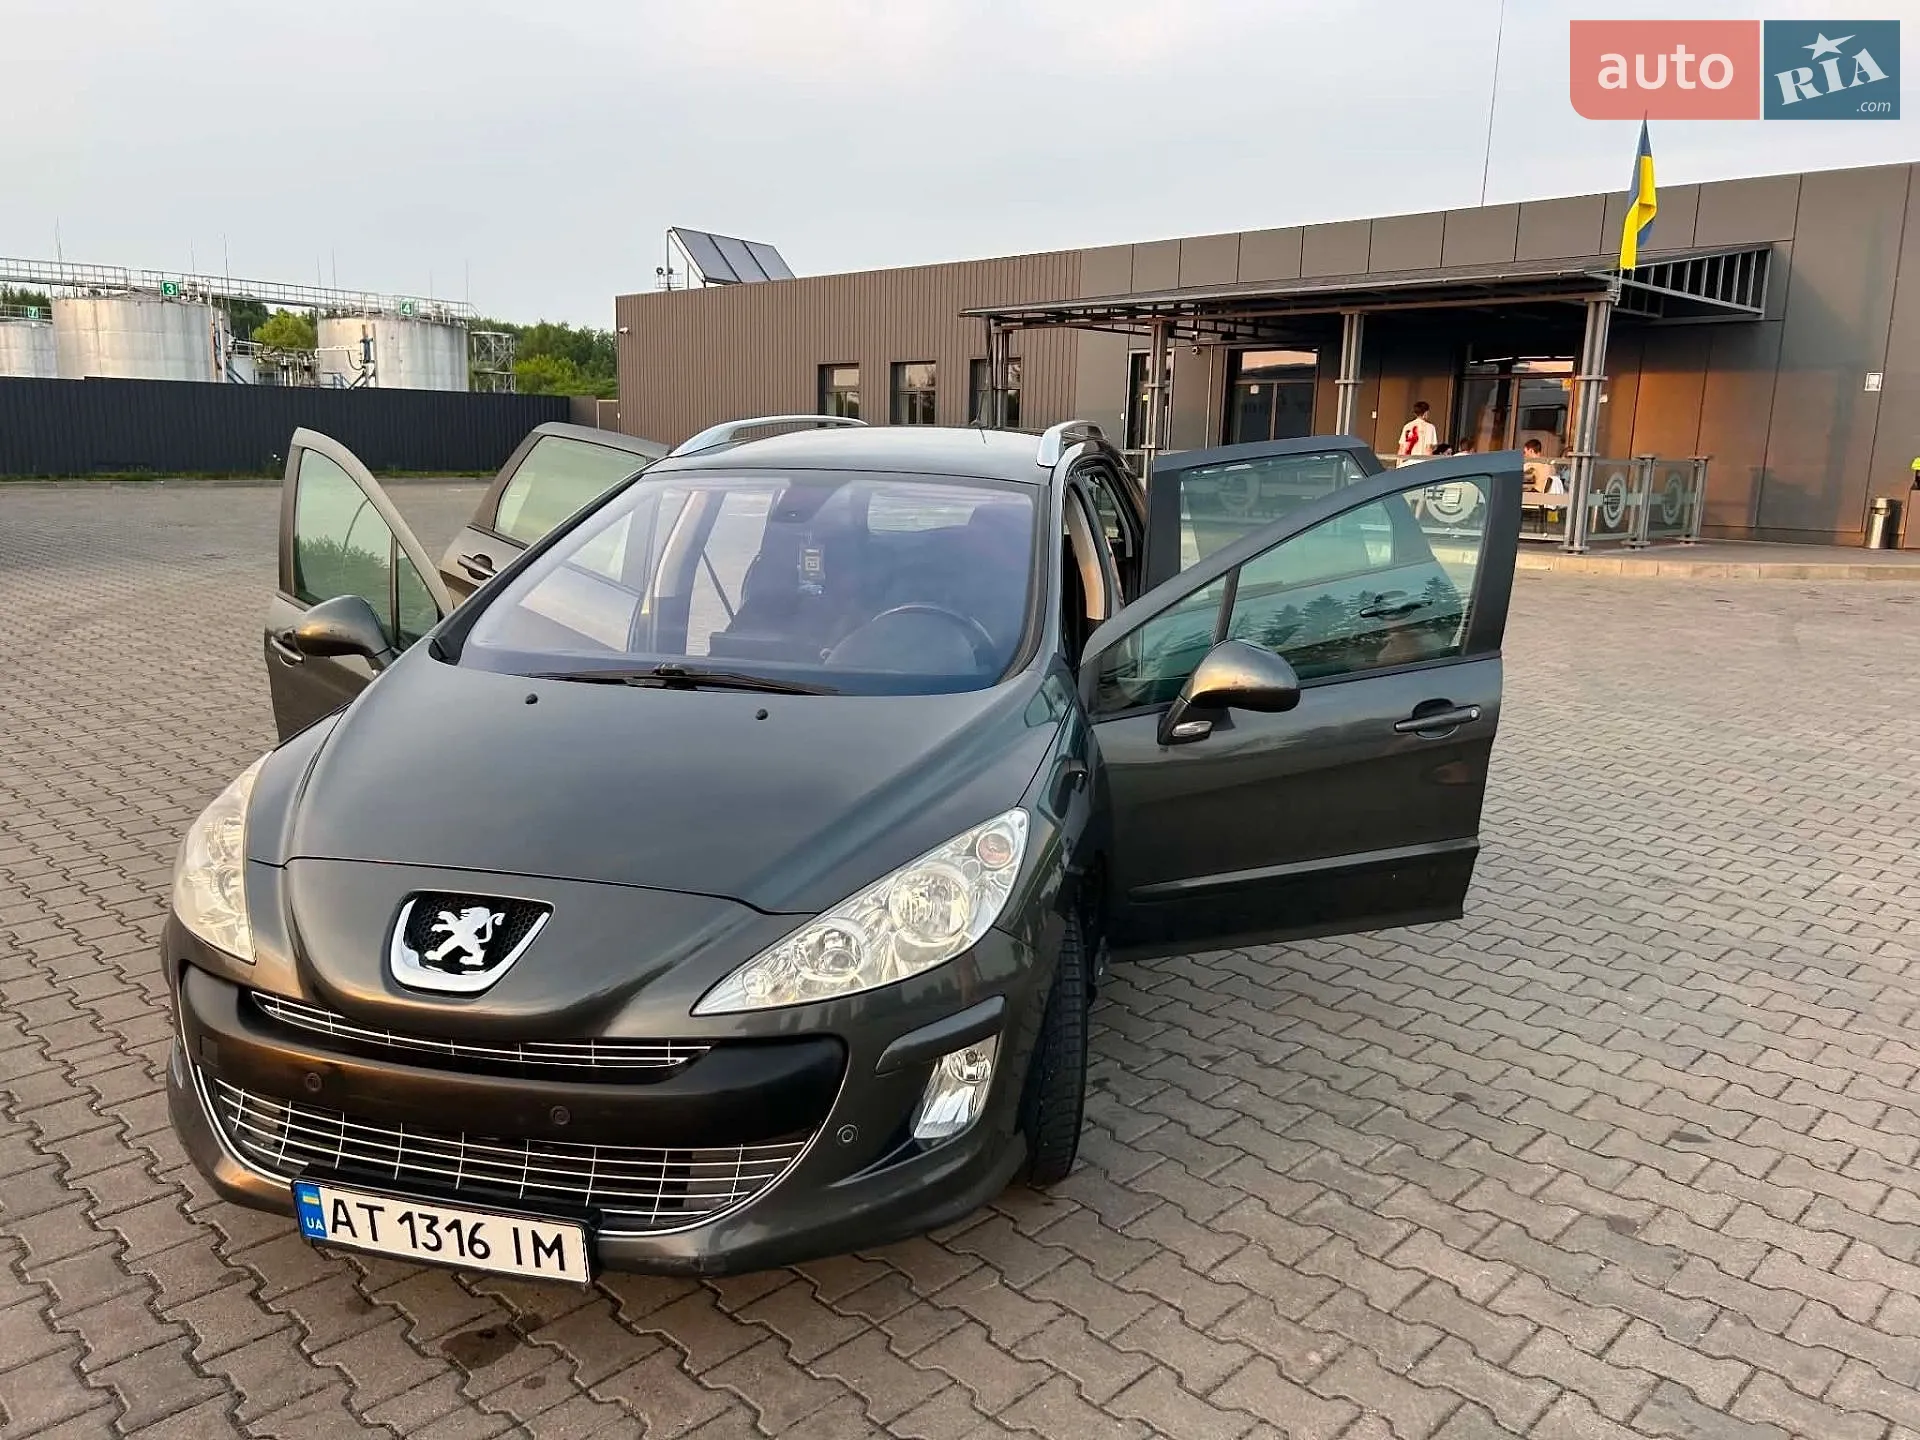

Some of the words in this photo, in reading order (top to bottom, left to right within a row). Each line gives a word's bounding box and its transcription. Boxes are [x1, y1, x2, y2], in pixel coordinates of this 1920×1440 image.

[166, 283, 175, 295] 3
[306, 1216, 324, 1230] UA
[331, 1198, 385, 1242] AT
[397, 1211, 491, 1259] 1316
[512, 1227, 566, 1271] IM
